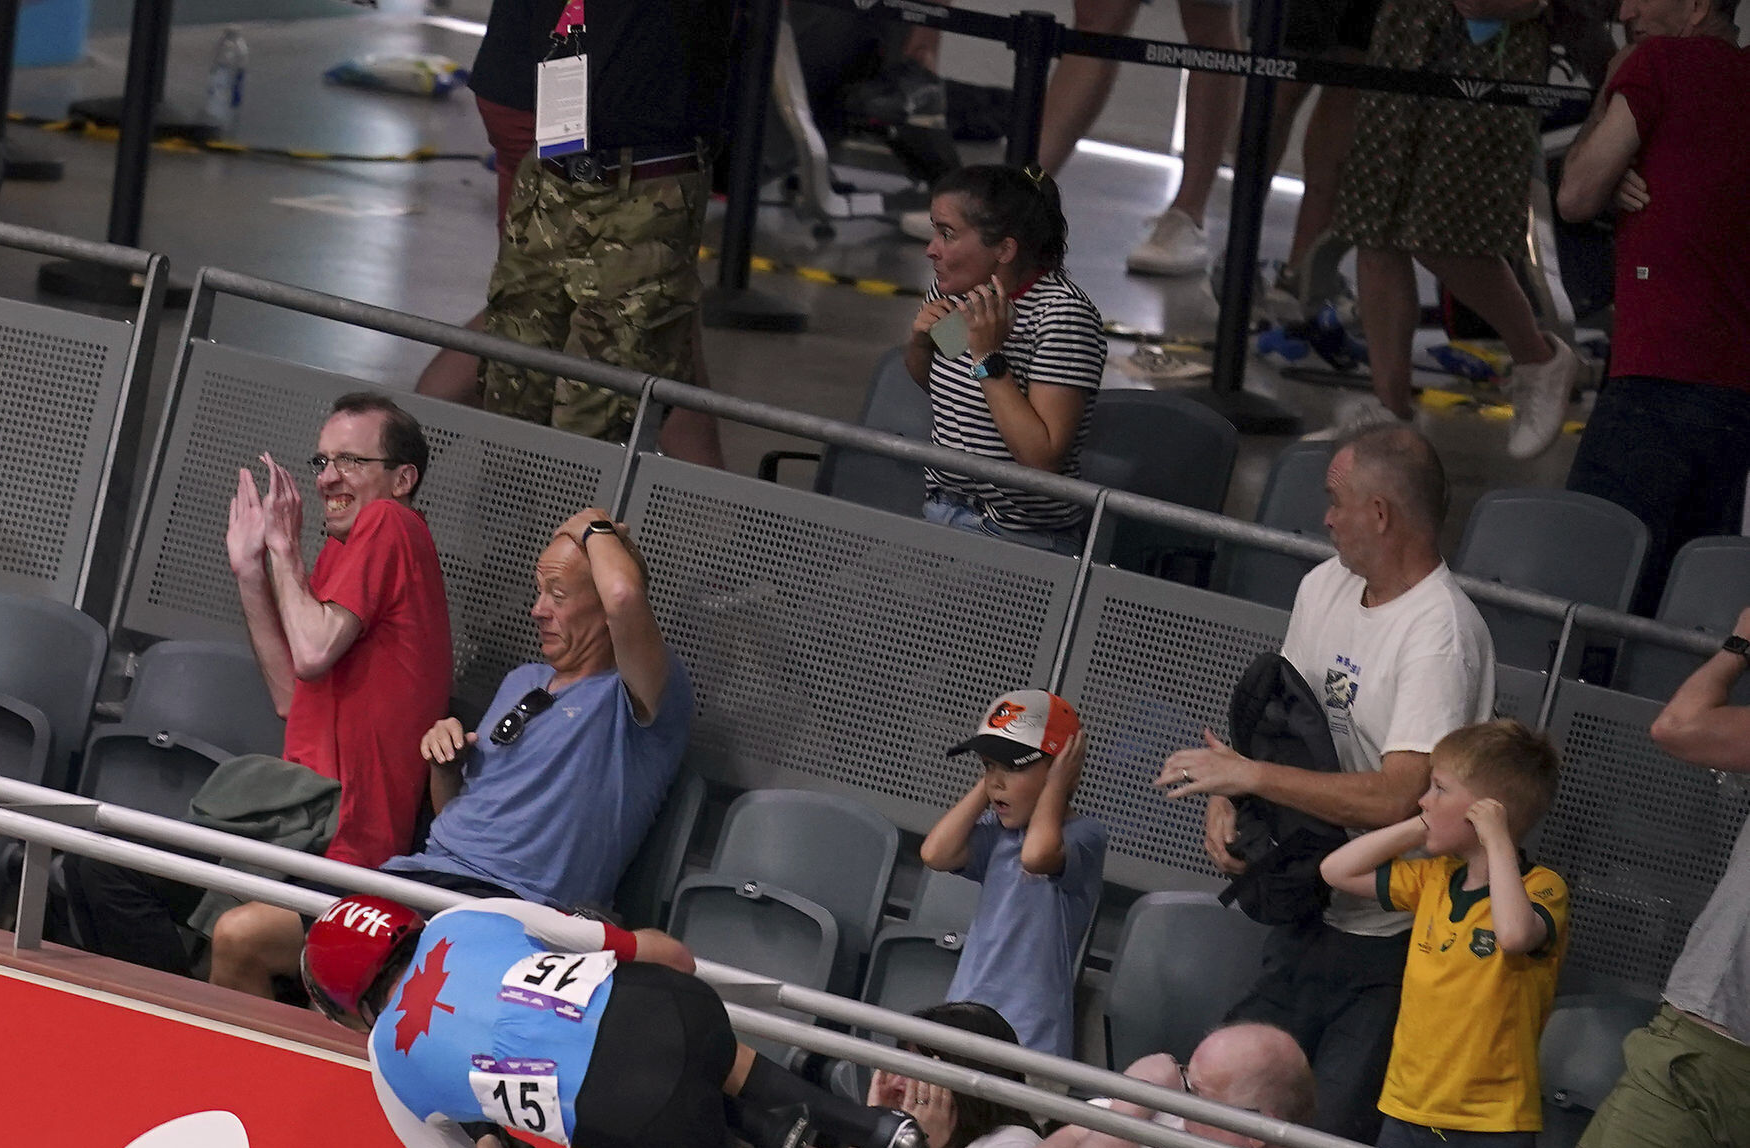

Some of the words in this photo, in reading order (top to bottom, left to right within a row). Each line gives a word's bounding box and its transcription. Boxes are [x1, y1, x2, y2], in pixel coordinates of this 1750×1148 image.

[1145, 43, 1251, 73] BIRMINGHAM
[1254, 61, 1297, 80] 2022
[522, 954, 587, 992] 15
[492, 1079, 546, 1133] 15
